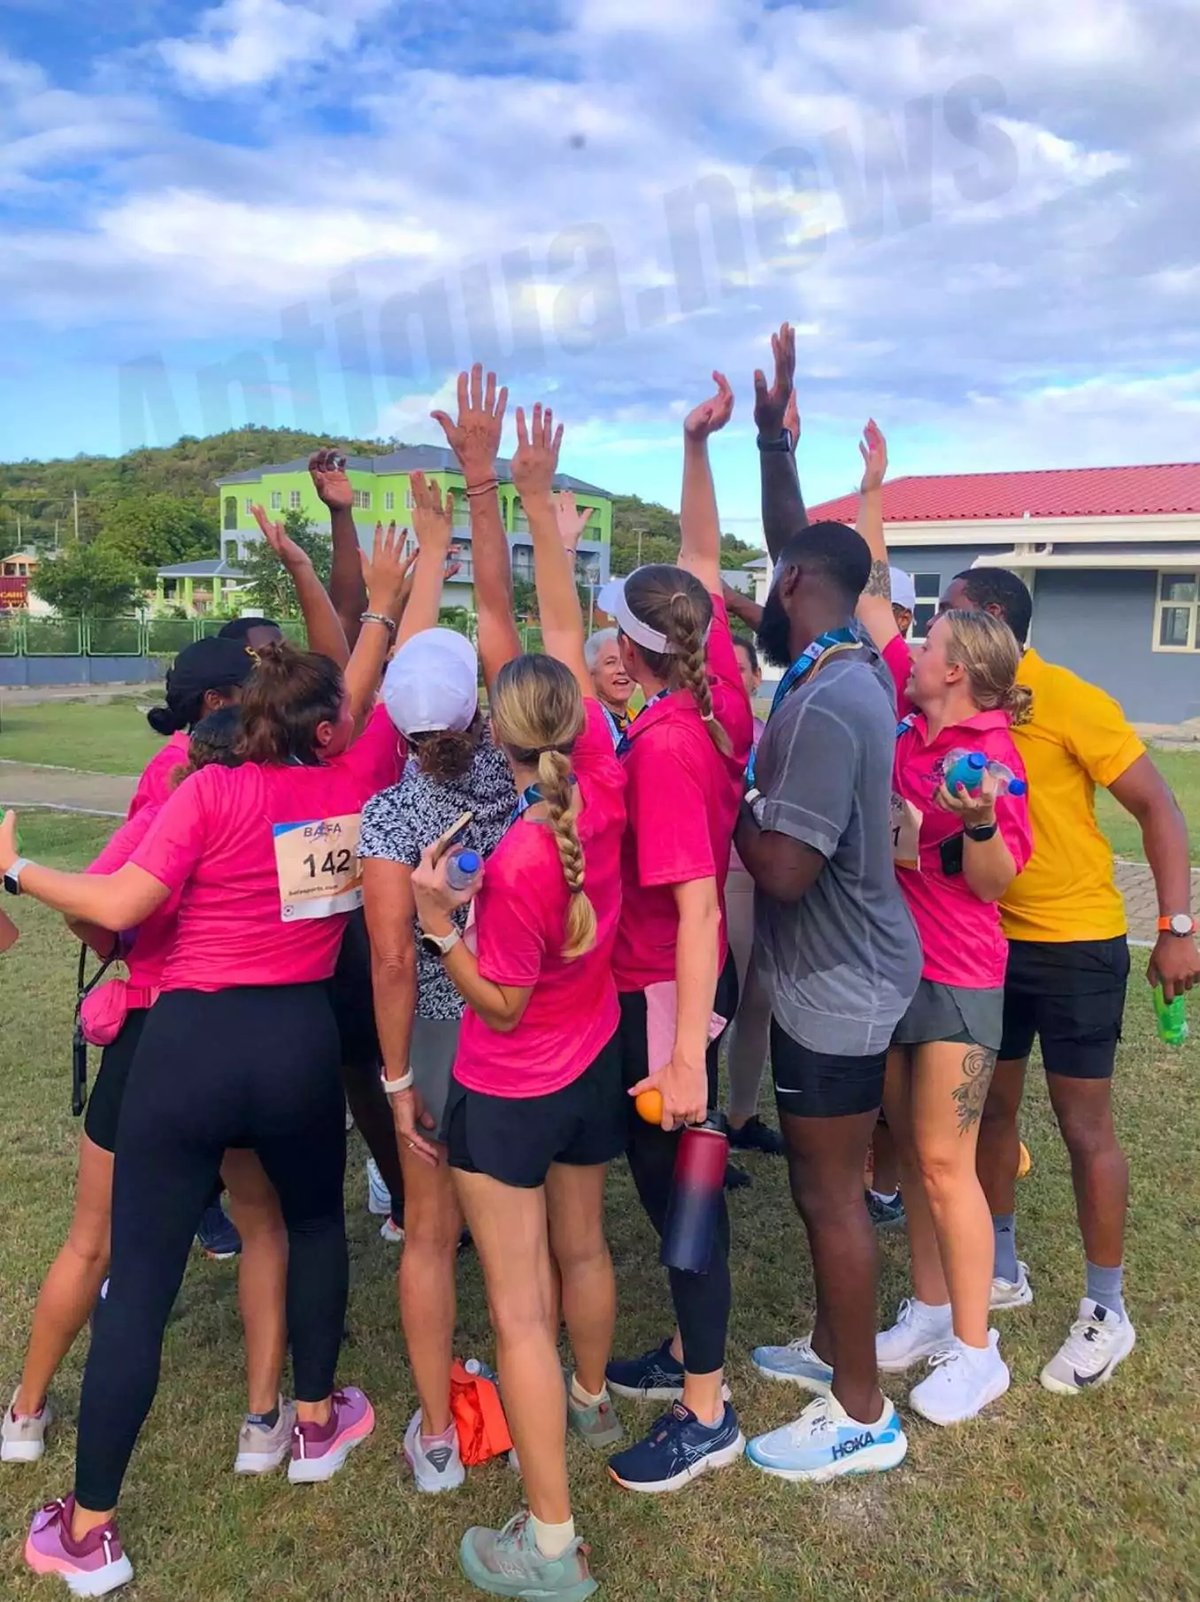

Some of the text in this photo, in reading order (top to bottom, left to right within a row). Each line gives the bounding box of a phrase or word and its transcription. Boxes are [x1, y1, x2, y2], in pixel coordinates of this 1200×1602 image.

[304, 822, 342, 837] BAFA
[303, 849, 351, 878] 142
[832, 1430, 875, 1460] HOKA
